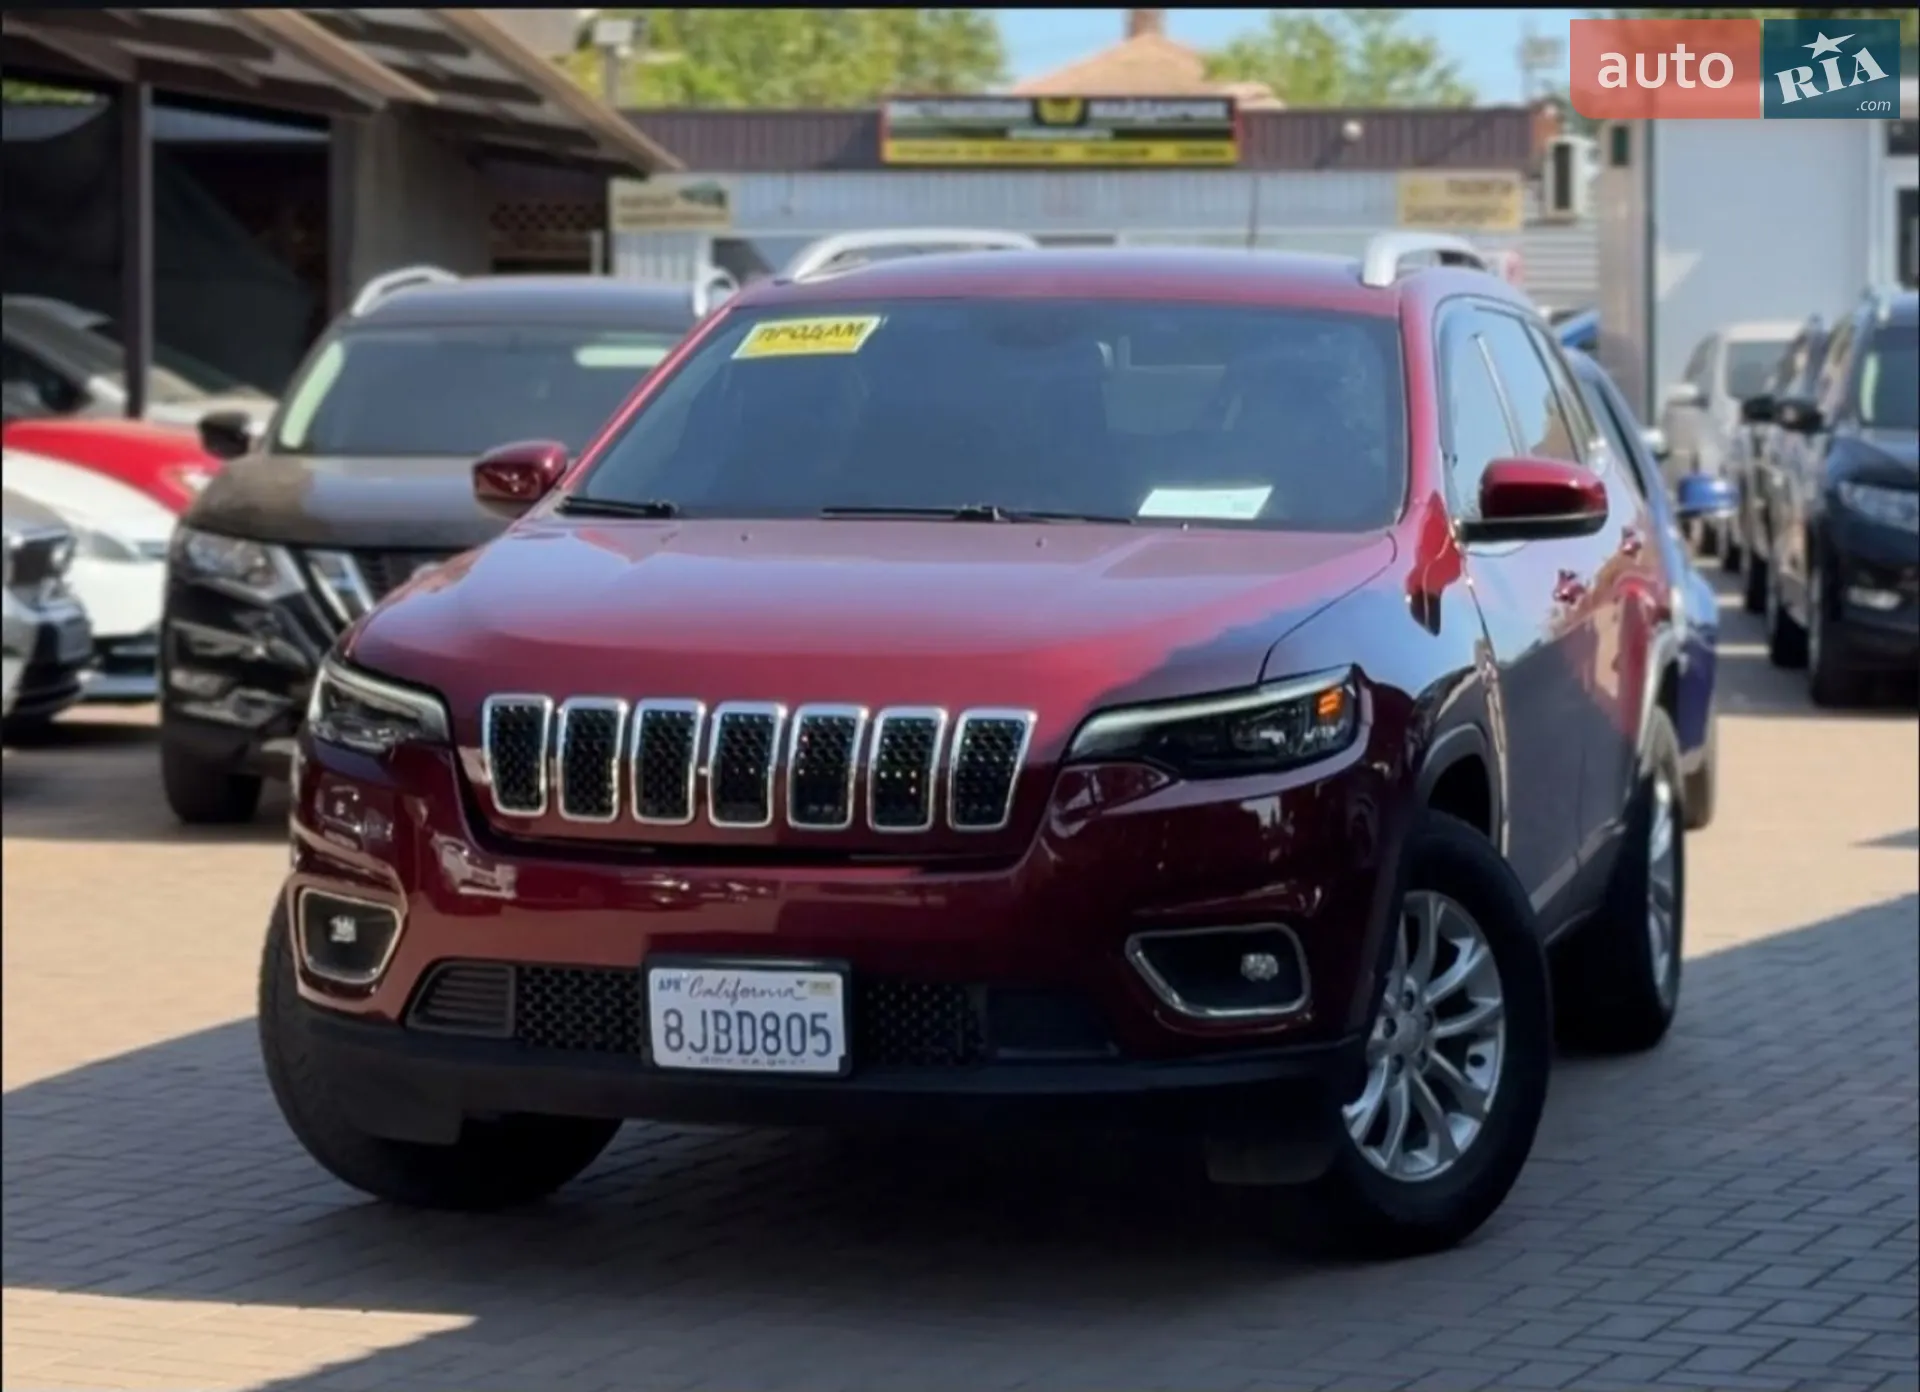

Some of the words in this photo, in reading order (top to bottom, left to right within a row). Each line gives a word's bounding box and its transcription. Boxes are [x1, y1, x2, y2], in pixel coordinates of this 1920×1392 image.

[758, 321, 866, 342] ПРОДАМ
[689, 976, 808, 1006] California
[663, 1008, 832, 1057] 8JBD805
